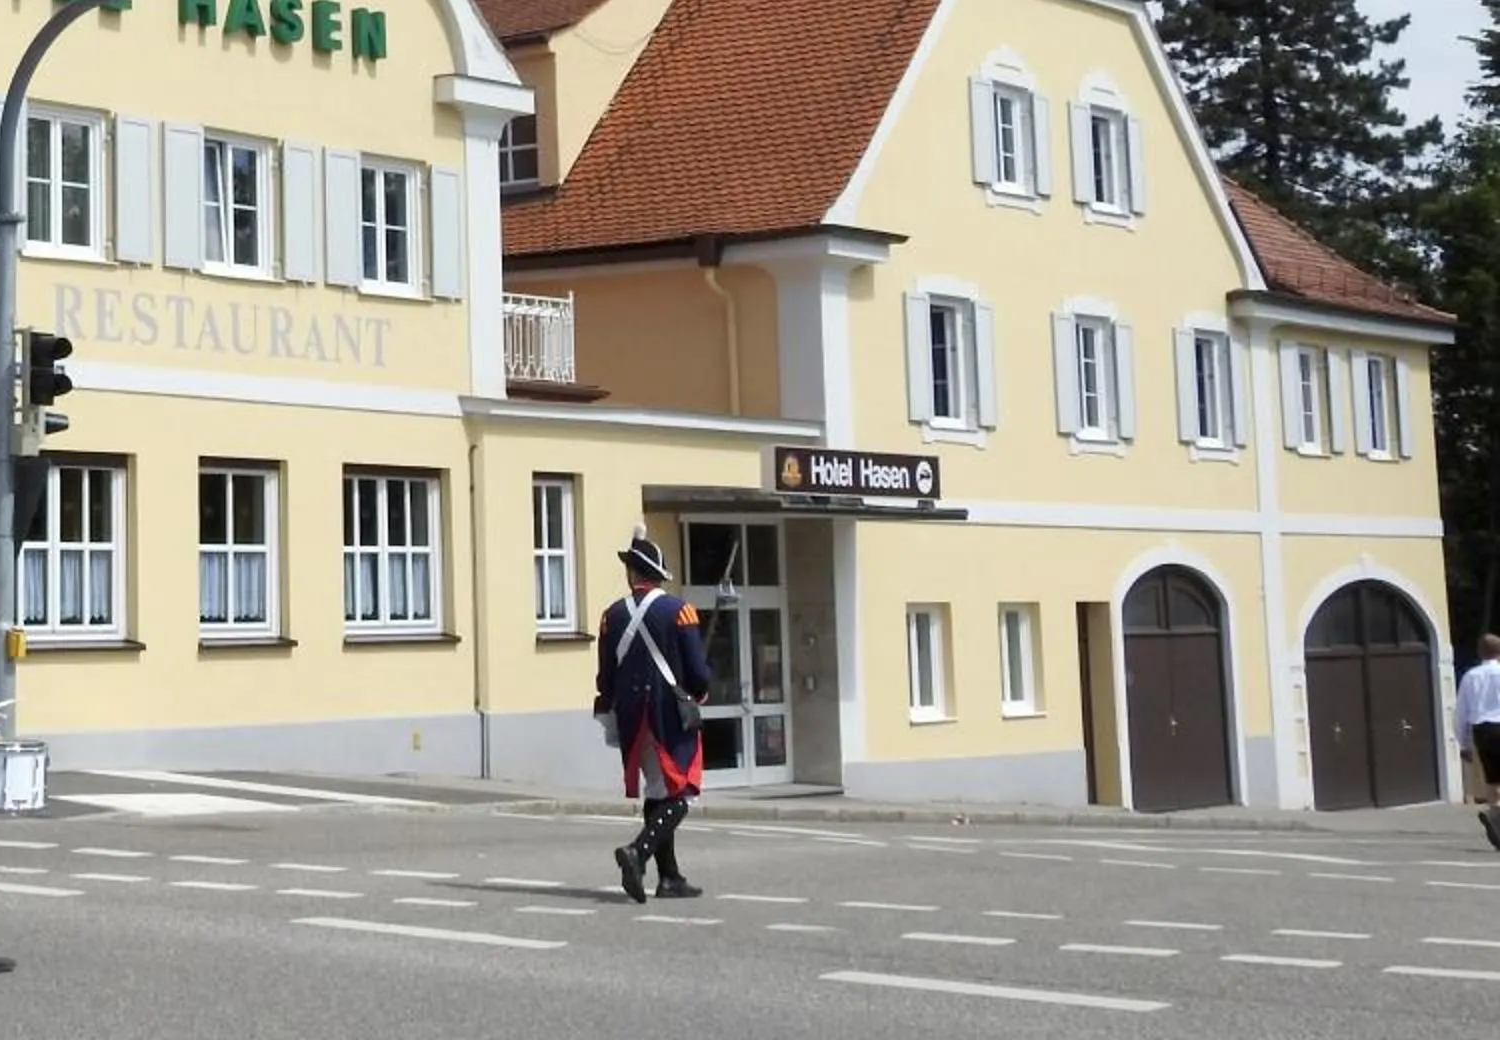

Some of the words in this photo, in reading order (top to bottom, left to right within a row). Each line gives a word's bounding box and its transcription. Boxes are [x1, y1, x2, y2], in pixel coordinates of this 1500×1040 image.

[53, 282, 391, 369] RESTAURANT
[810, 455, 853, 487] Hotel
[859, 458, 911, 489] Hasen
